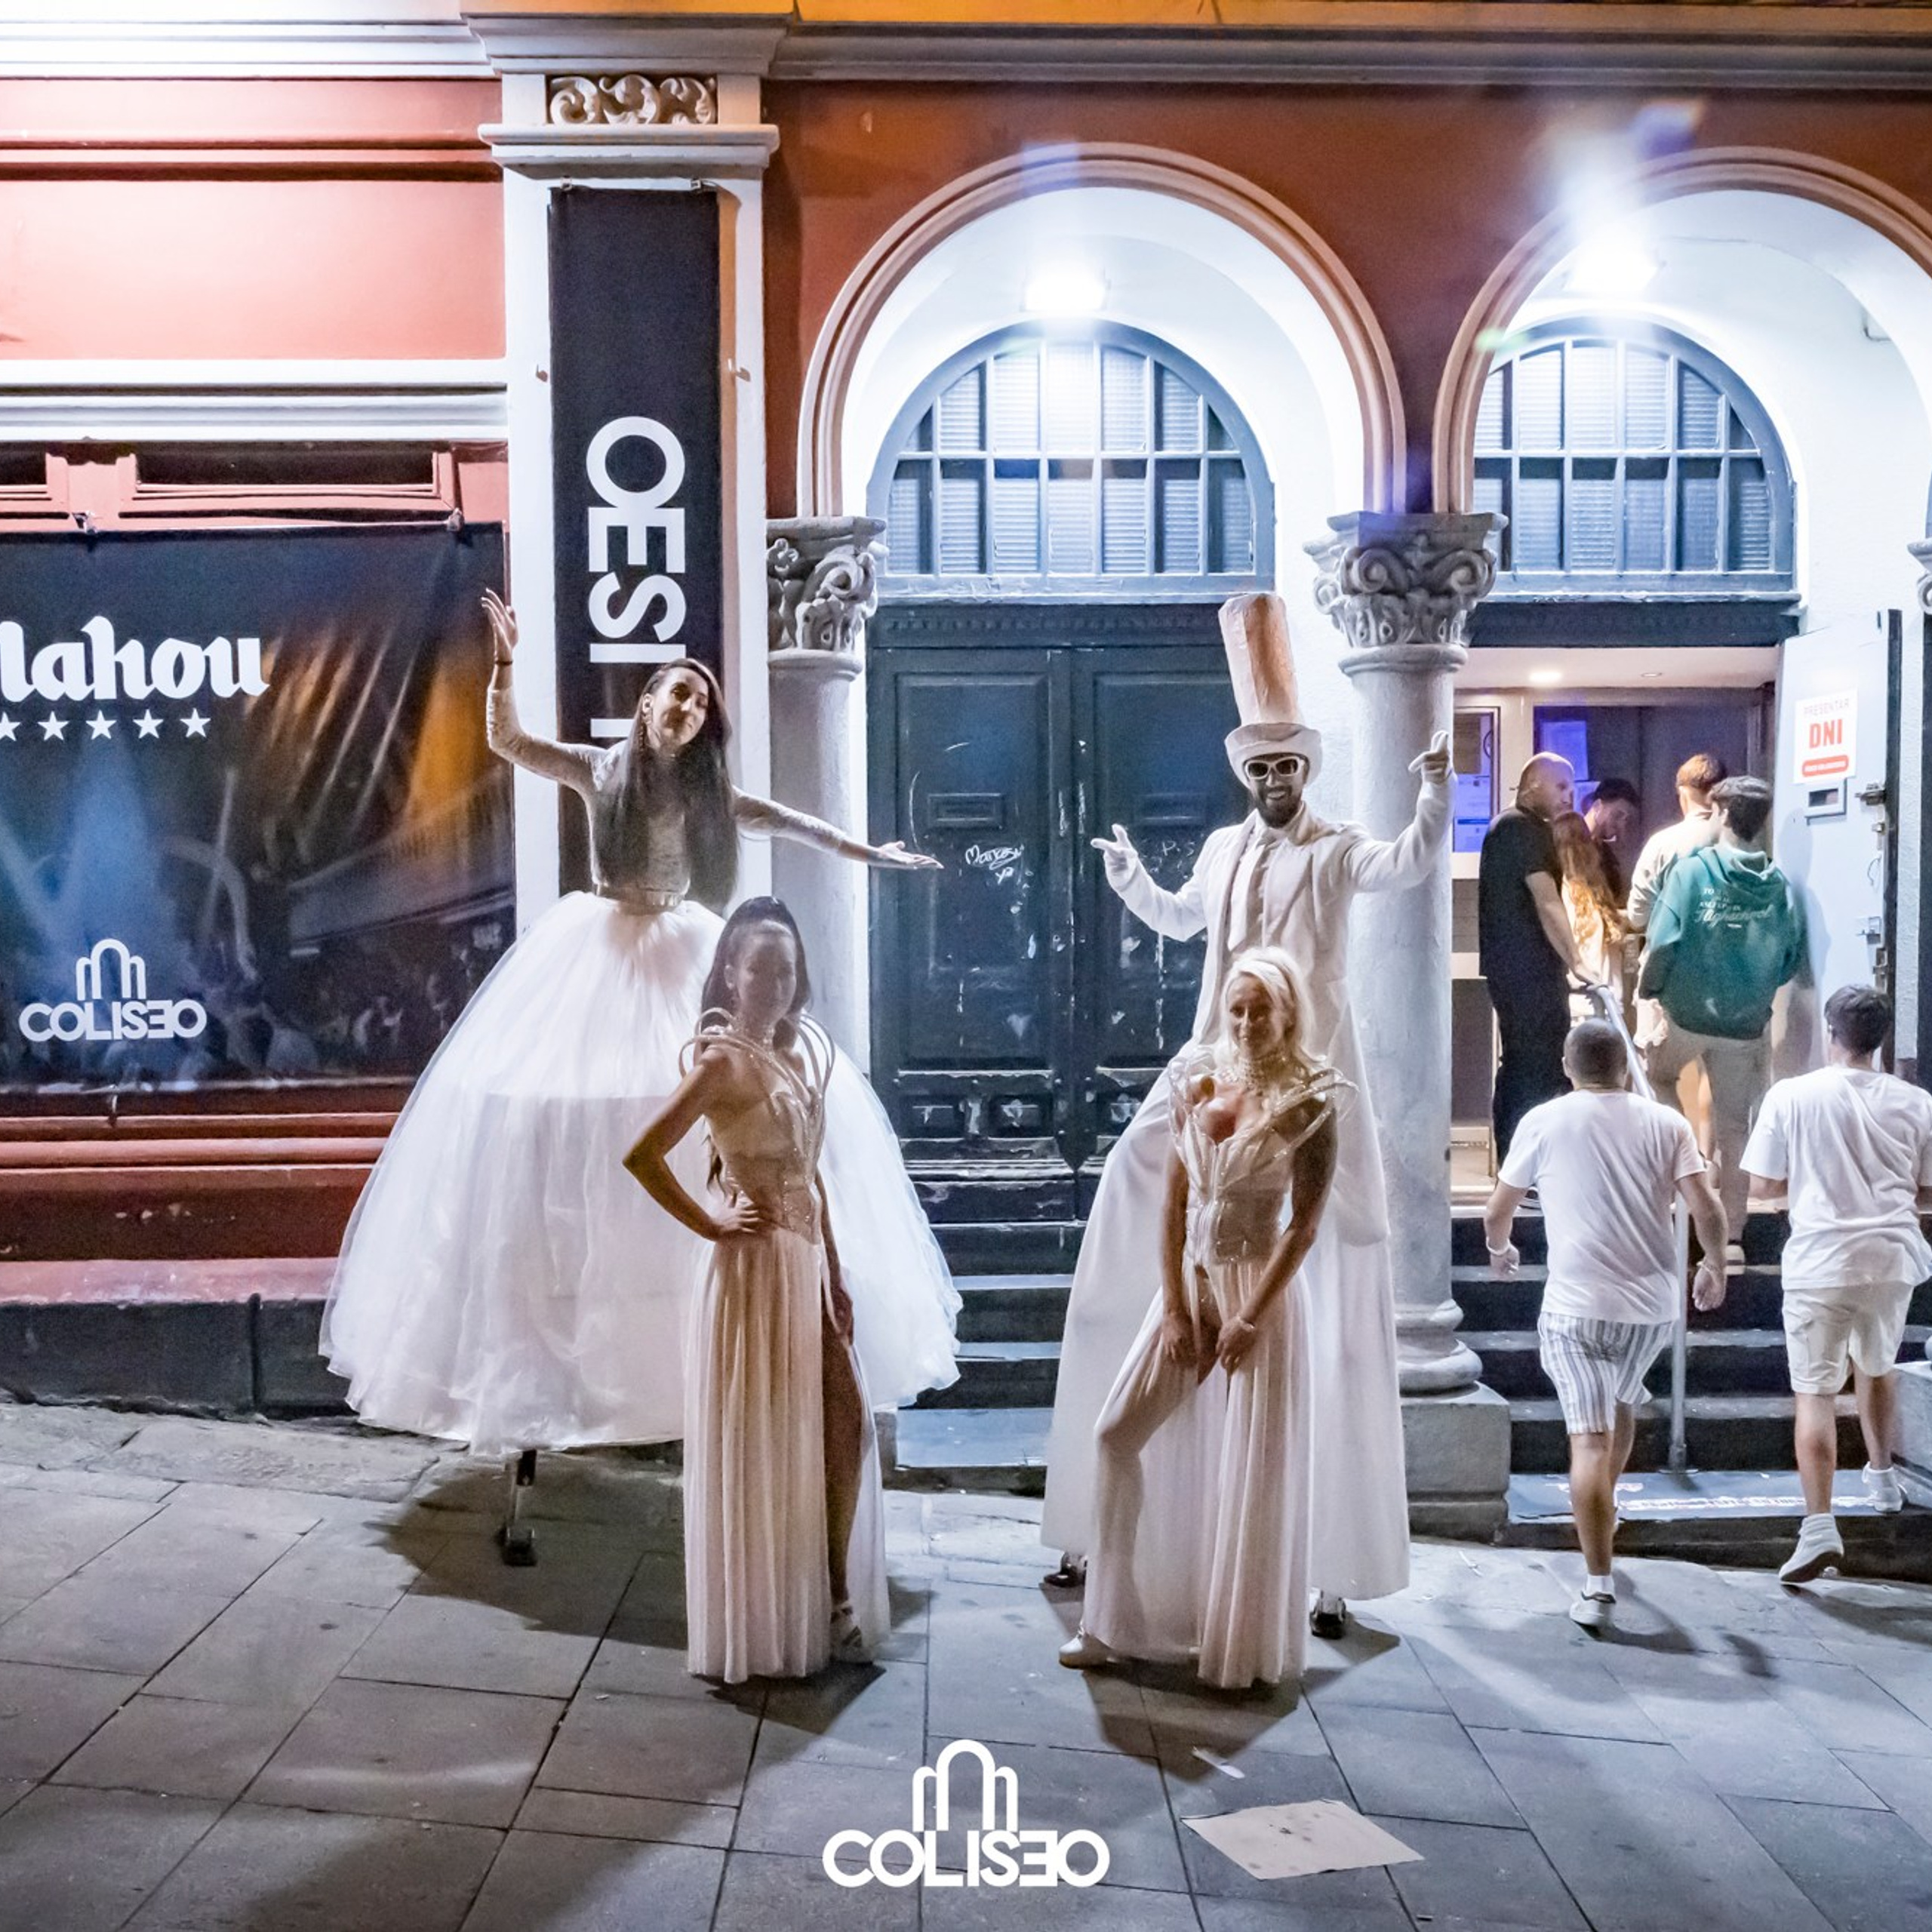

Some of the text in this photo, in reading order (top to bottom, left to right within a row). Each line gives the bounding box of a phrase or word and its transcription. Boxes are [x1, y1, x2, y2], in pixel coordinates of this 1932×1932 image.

[586, 416, 687, 738] ISEO
[1809, 718, 1843, 749] DNI
[19, 998, 208, 1042] COLISEO
